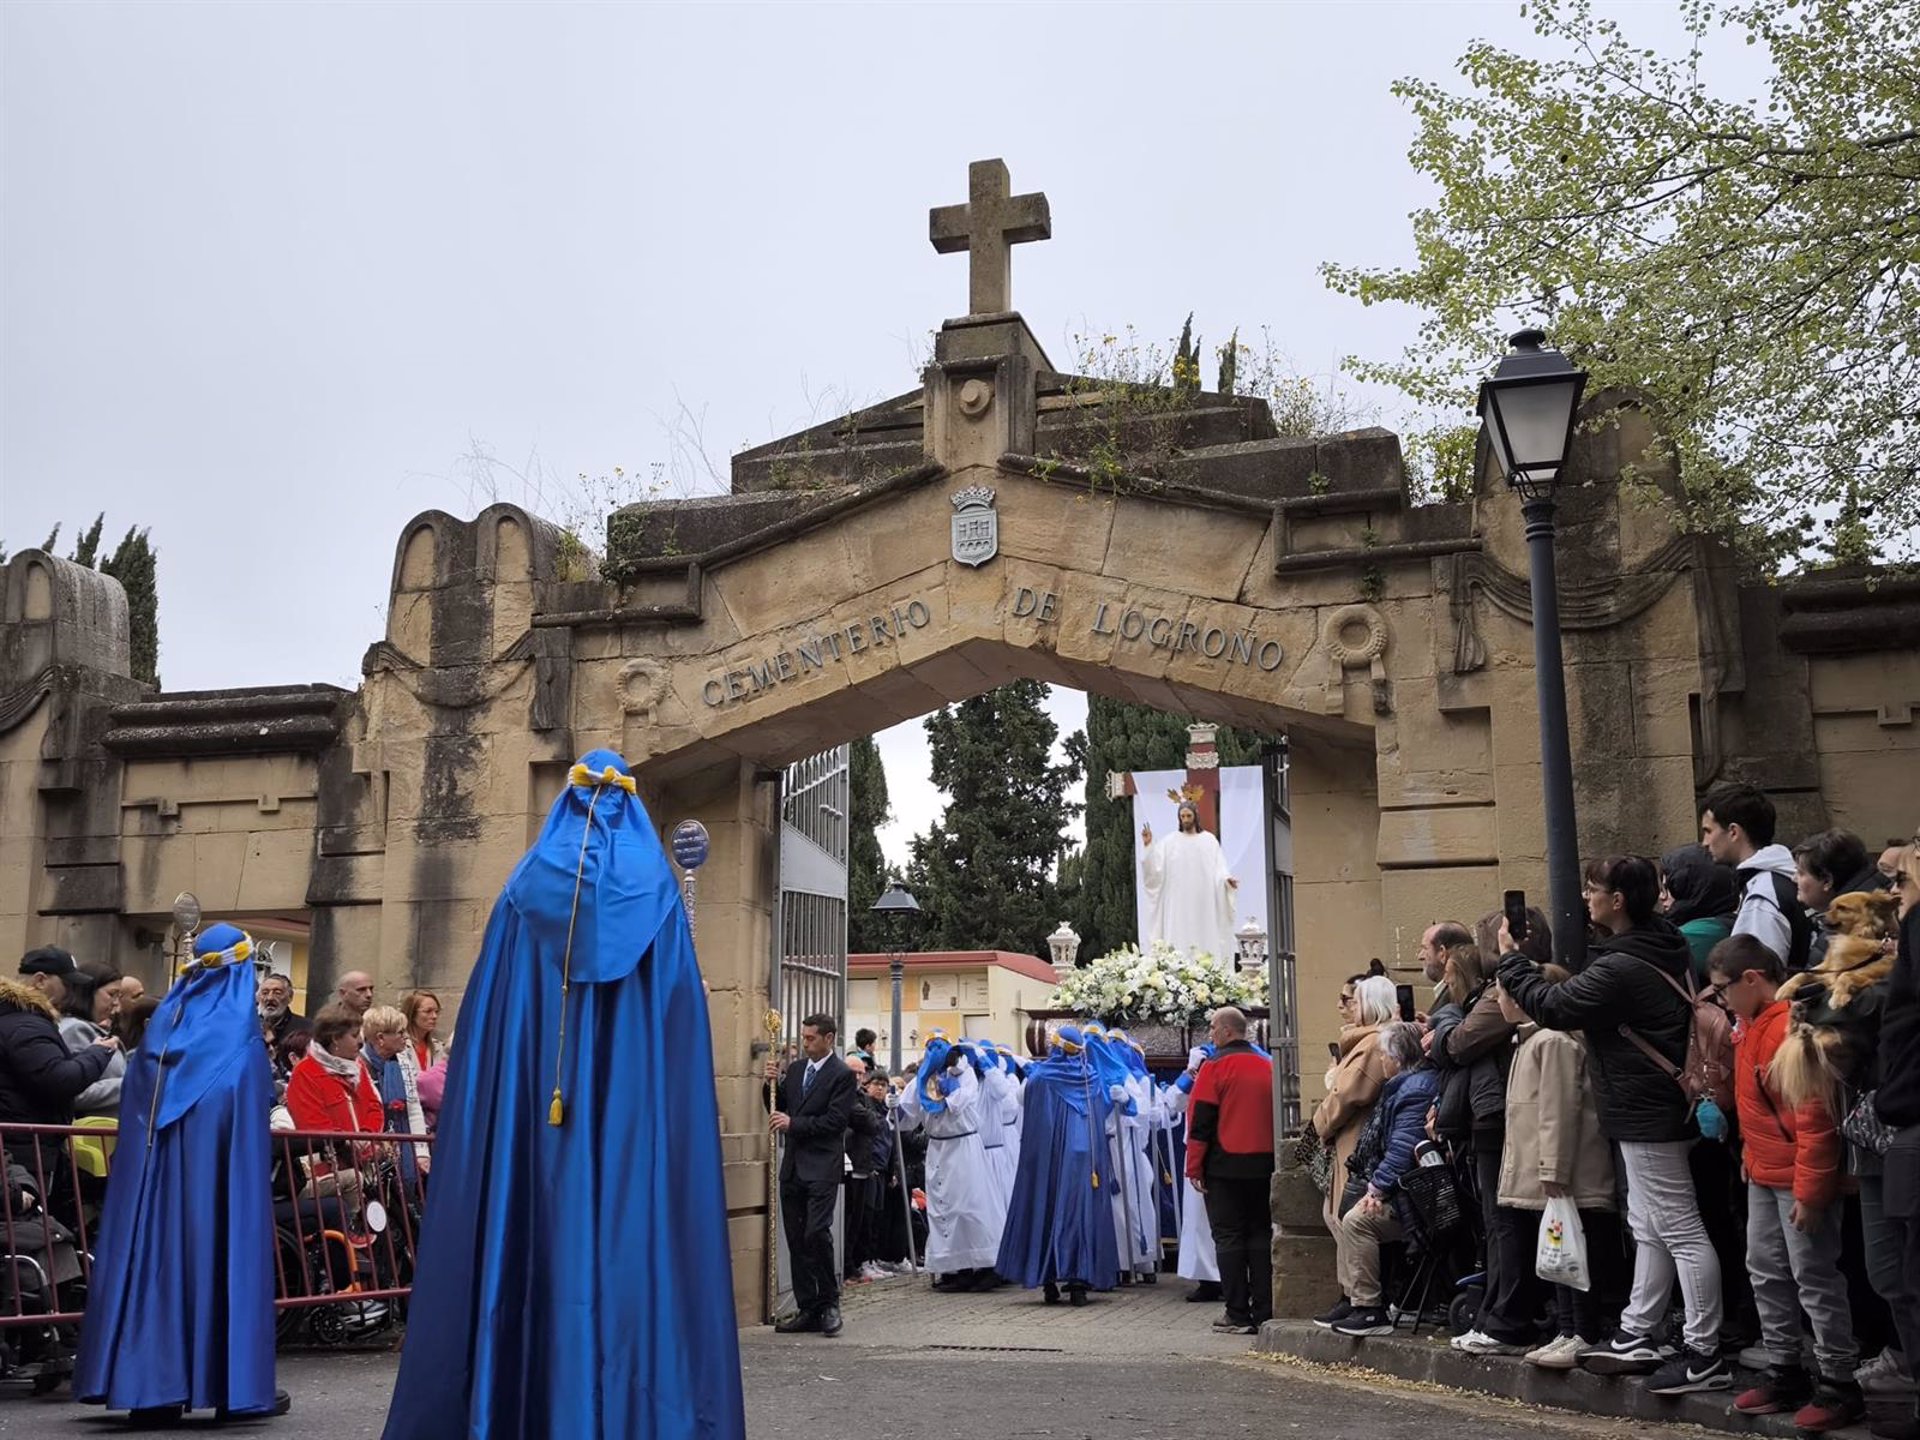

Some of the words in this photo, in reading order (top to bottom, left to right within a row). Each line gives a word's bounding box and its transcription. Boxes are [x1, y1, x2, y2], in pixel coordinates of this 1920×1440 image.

[703, 600, 930, 707] CEMENTERIO
[1012, 587, 1061, 623] DE
[1091, 602, 1283, 671] LOGROÑO
